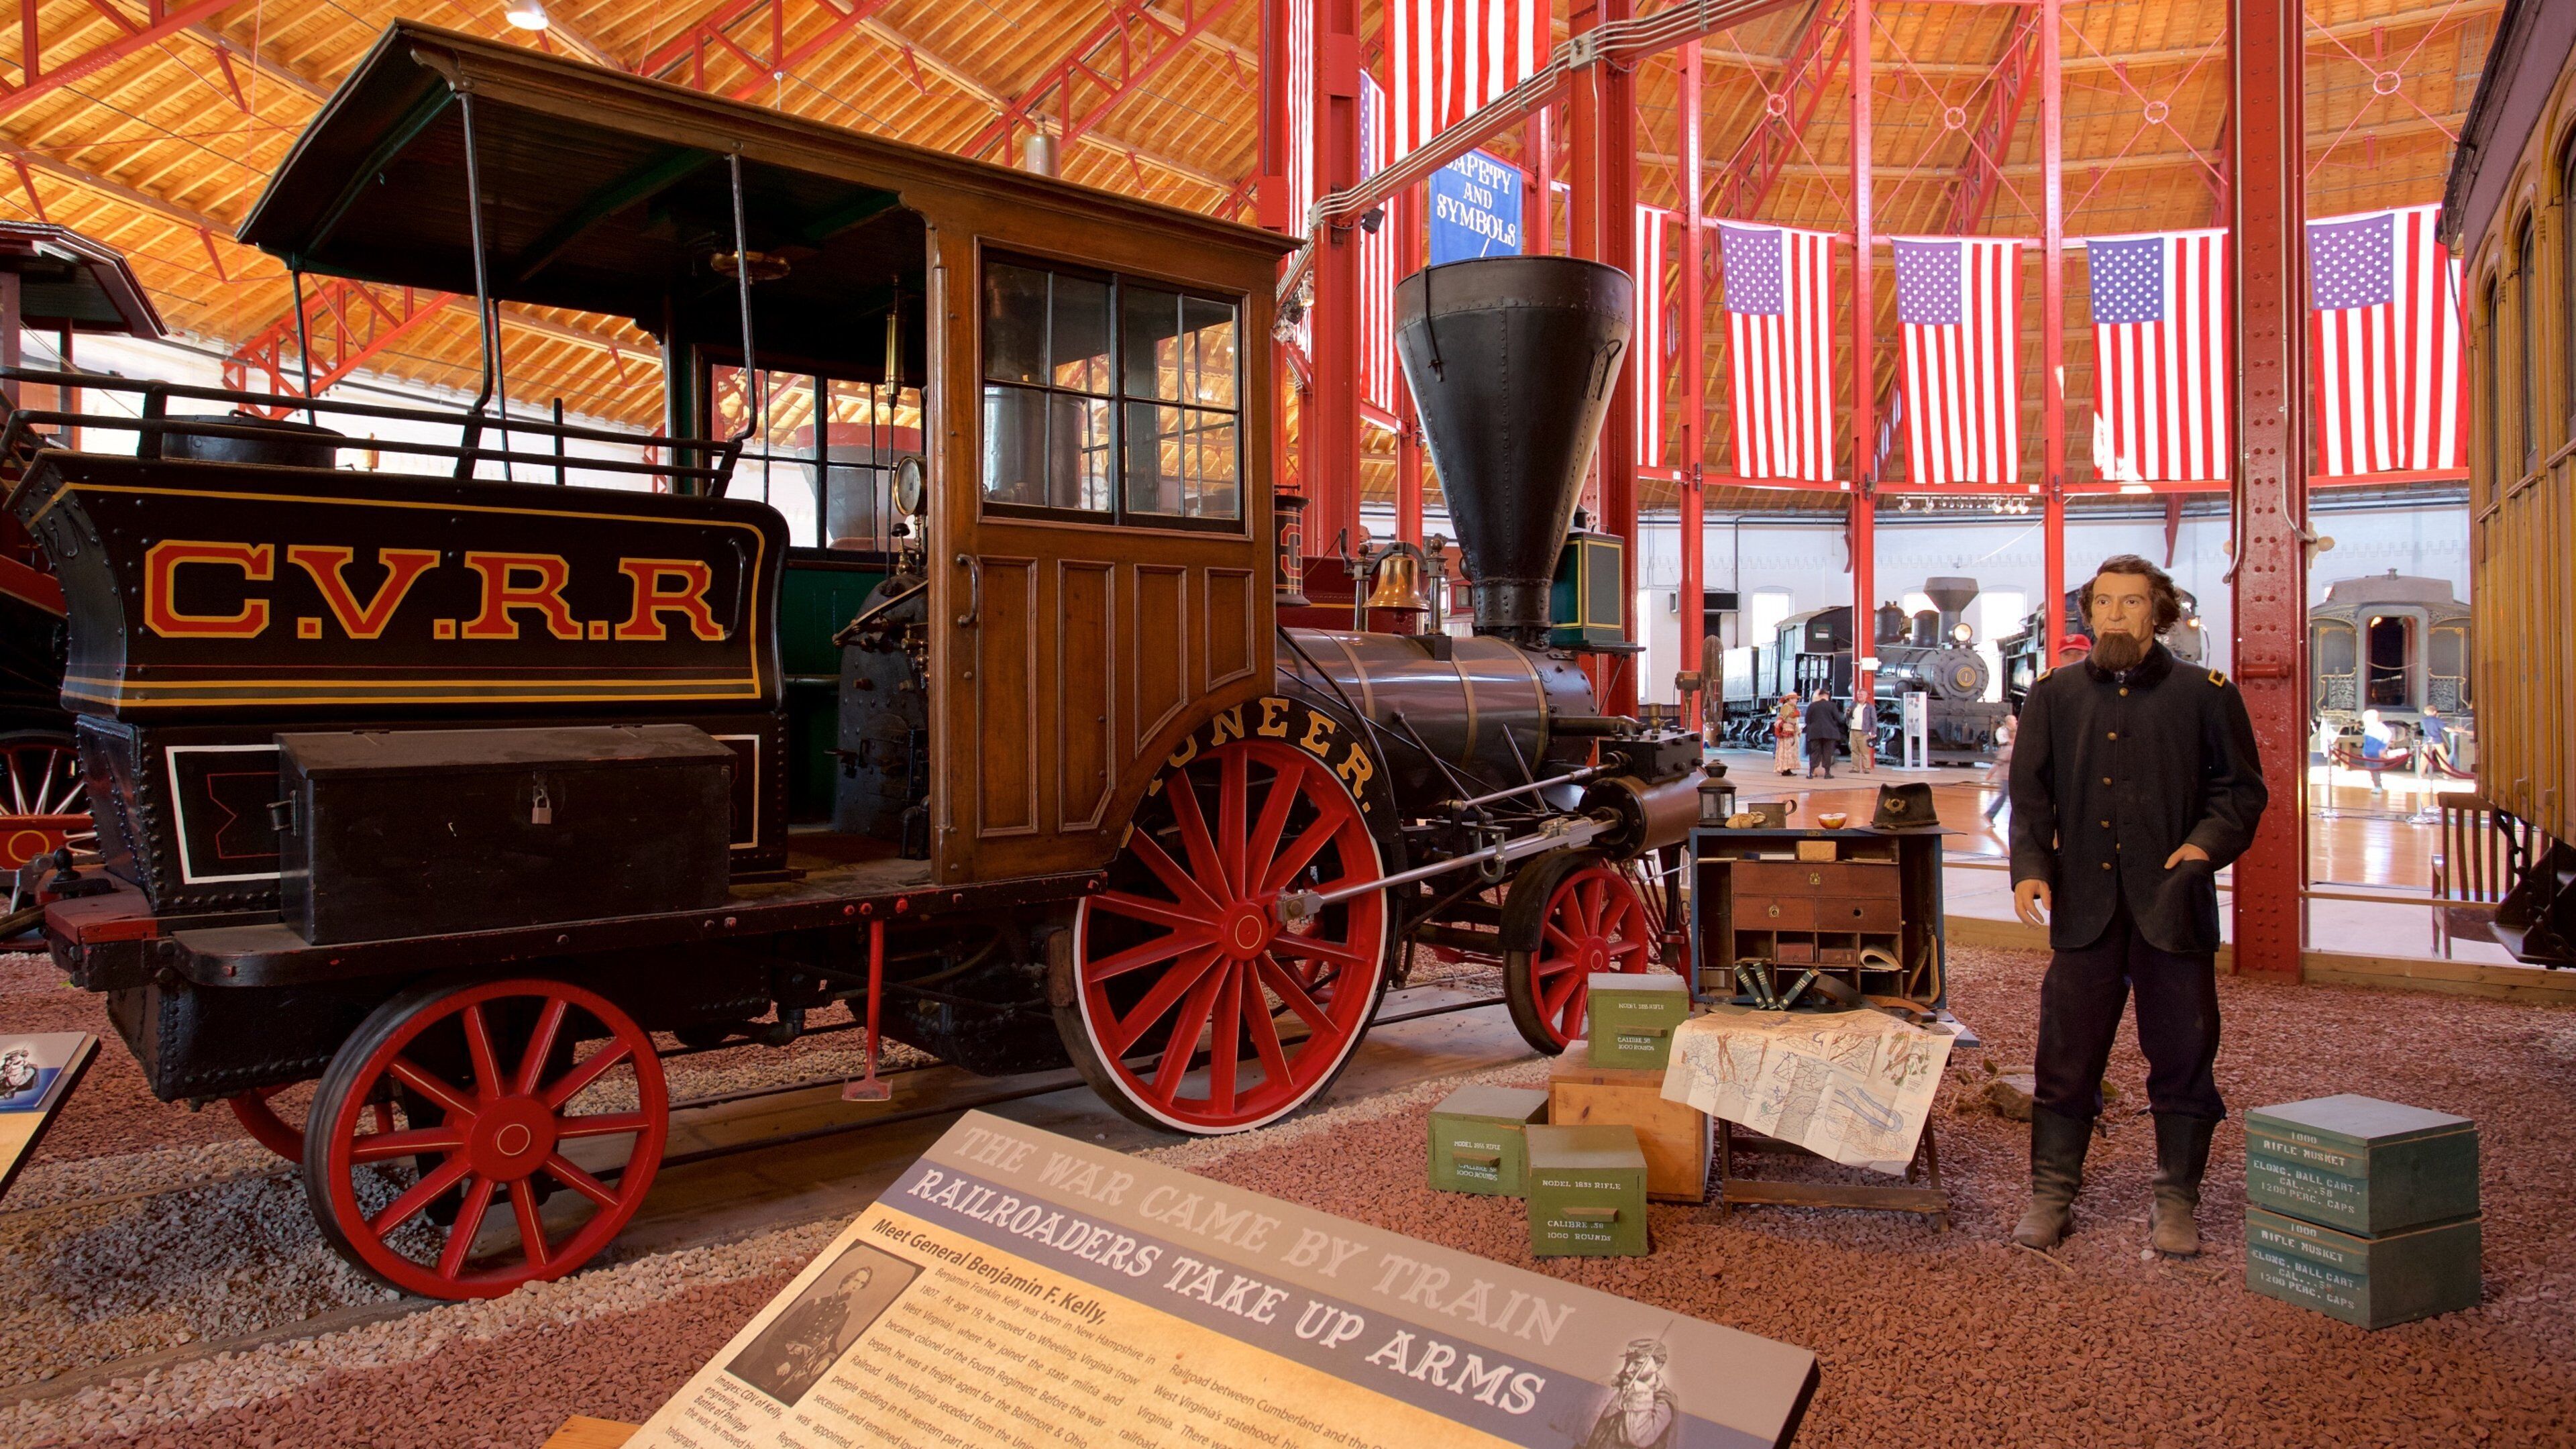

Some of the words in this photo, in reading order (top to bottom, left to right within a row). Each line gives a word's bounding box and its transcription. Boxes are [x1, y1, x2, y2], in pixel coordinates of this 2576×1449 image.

[1463, 182, 1493, 210] AND
[1437, 193, 1516, 248] SYMBOLS
[1486, 1143, 1501, 1151] RIFLE
[2263, 1140, 2298, 1156] RIFLE
[2303, 1148, 2346, 1167] MUSKET
[2291, 1131, 2317, 1144] 1000
[1456, 1169, 1474, 1177] 1000
[1474, 1171, 1498, 1181] ROUNDS
[1595, 1181, 1621, 1190] RIFLE
[2296, 1170, 2323, 1185] BALL
[2261, 1181, 2286, 1195] 1200
[2327, 1199, 2355, 1214] CAPS
[953, 1126, 1039, 1174] THE
[1036, 1150, 1134, 1206] WAR
[1138, 1184, 1282, 1254] CAME
[1279, 1226, 1369, 1278] BY
[1371, 1252, 1576, 1346] TRAIN
[1547, 1220, 1588, 1229] CALIBRE
[1574, 1233, 1612, 1242] ROUNDS
[2291, 1222, 2317, 1237] 1000
[2261, 1230, 2296, 1248] RIFLE
[2301, 1241, 2343, 1263] MUSKET
[871, 1218, 912, 1243] Meet
[909, 1233, 972, 1266] General
[965, 1255, 1043, 1297] Benjamin
[1042, 1285, 1061, 1304] F.
[1057, 1291, 1107, 1326] Kelly,
[2294, 1262, 2323, 1279] BALL
[906, 1168, 1163, 1277] RAILROADERS
[1162, 1255, 1289, 1325] TAKE
[1294, 1299, 1364, 1349] UP
[1364, 1329, 1546, 1414] ARMS
[2260, 1272, 2286, 1287] 1200
[2326, 1293, 2355, 1309] CAPS
[934, 1267, 970, 1288] Benjamin
[969, 1281, 1002, 1301] Franklin
[1000, 1294, 1022, 1311] Kelly
[1022, 1305, 1040, 1317] was
[1039, 1309, 1062, 1326] born
[1061, 1321, 1073, 1331] in
[1073, 1324, 1095, 1340] New
[1094, 1332, 1144, 1360] Hampshire
[1144, 1353, 1156, 1365] in
[919, 1284, 941, 1299] 1807.
[941, 1294, 955, 1305] At
[953, 1301, 970, 1312] age
[970, 1306, 983, 1320] 19,
[982, 1311, 996, 1324] he
[995, 1319, 1028, 1336] moved
[1024, 1330, 1036, 1341] to
[1036, 1334, 1077, 1360] Wheeling,
[1079, 1352, 1114, 1375] Virginia
[1113, 1368, 1140, 1385] (now
[902, 1301, 922, 1316] West
[922, 1309, 955, 1332] Virginia),
[956, 1327, 983, 1344] where
[983, 1337, 997, 1350] he
[994, 1344, 1028, 1363] joined
[1027, 1358, 1044, 1371] the
[1044, 1367, 1069, 1383] state
[1070, 1379, 1100, 1397] militia
[1102, 1392, 1125, 1407] and
[867, 1336, 892, 1356] began,
[892, 1348, 906, 1361] he
[904, 1356, 922, 1369] was
[920, 1364, 928, 1373] a
[927, 1365, 957, 1386] freight
[955, 1381, 981, 1398] agent
[979, 1390, 996, 1403] for
[994, 1398, 1011, 1413] the
[1010, 1405, 1054, 1434] Baltimore
[1053, 1426, 1065, 1438] &
[883, 1318, 915, 1339] became
[914, 1334, 946, 1352] colonel
[942, 1347, 957, 1356] of
[952, 1350, 968, 1364] the
[967, 1356, 996, 1377] Fourth
[995, 1369, 1038, 1397] Regiment.
[1038, 1389, 1069, 1411] Before
[1068, 1405, 1086, 1419] the
[1086, 1413, 1106, 1428] war
[693, 1394, 716, 1412] Battle
[712, 1408, 727, 1417] of
[720, 1411, 752, 1432] Philippi
[704, 1386, 741, 1411] engraving:
[714, 1375, 740, 1395] Images:
[739, 1389, 759, 1403] CDV
[753, 1399, 768, 1407] of
[762, 1403, 783, 1420] Kelly,
[812, 1393, 849, 1417] secession
[846, 1411, 867, 1426] and
[829, 1375, 859, 1393] people
[856, 1388, 889, 1411] residing
[885, 1401, 898, 1413] in
[896, 1407, 912, 1421] the
[910, 1415, 944, 1438] western
[849, 1354, 883, 1377] Railroad.
[884, 1371, 908, 1390] When
[907, 1383, 938, 1405] Virginia
[936, 1400, 975, 1423] seceded
[971, 1415, 994, 1434] from
[994, 1428, 1012, 1442] the
[1153, 1383, 1178, 1403] West
[1178, 1394, 1223, 1421] Virginia's
[1169, 1363, 1212, 1387] Railroad
[1209, 1379, 1255, 1406] between
[1256, 1399, 1324, 1434] Cumberland
[1322, 1428, 1348, 1444] and
[684, 1407, 698, 1419] the
[696, 1414, 712, 1429] war,
[708, 1421, 722, 1434] he
[794, 1412, 812, 1426] was
[1136, 1404, 1173, 1431] Virginia.
[1179, 1424, 1210, 1446] There
